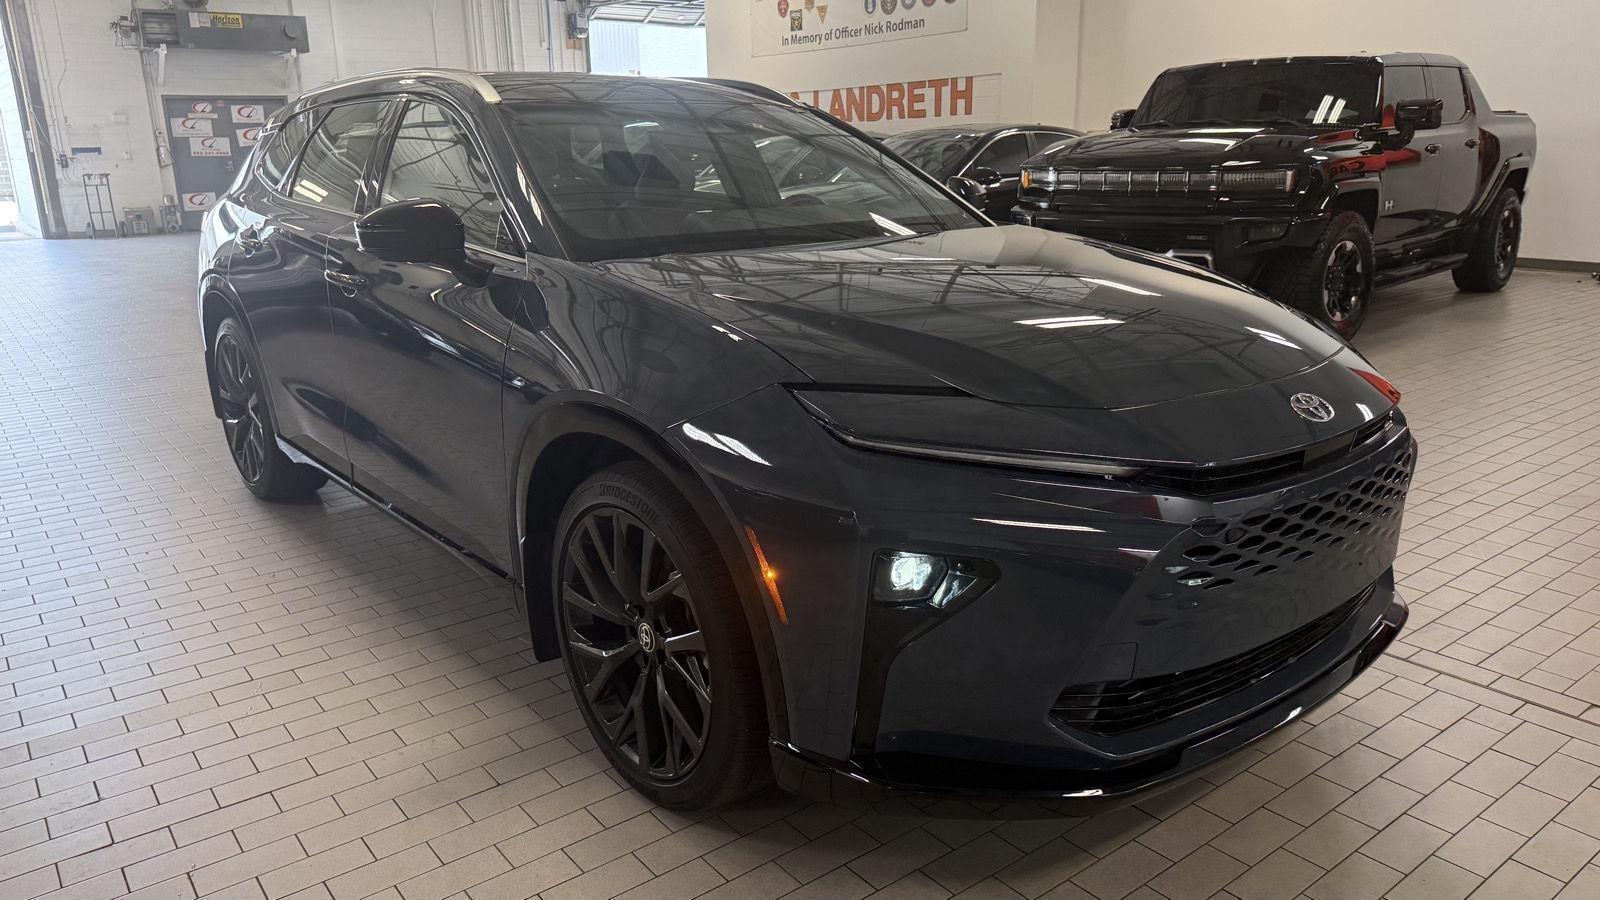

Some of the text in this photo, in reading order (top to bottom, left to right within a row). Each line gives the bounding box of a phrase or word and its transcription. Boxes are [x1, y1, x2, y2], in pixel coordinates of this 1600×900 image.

[781, 18, 925, 46] In Memory of Officer Nick Rodman
[1384, 200, 1394, 210] H
[599, 483, 661, 523] BRIDGESTONE
